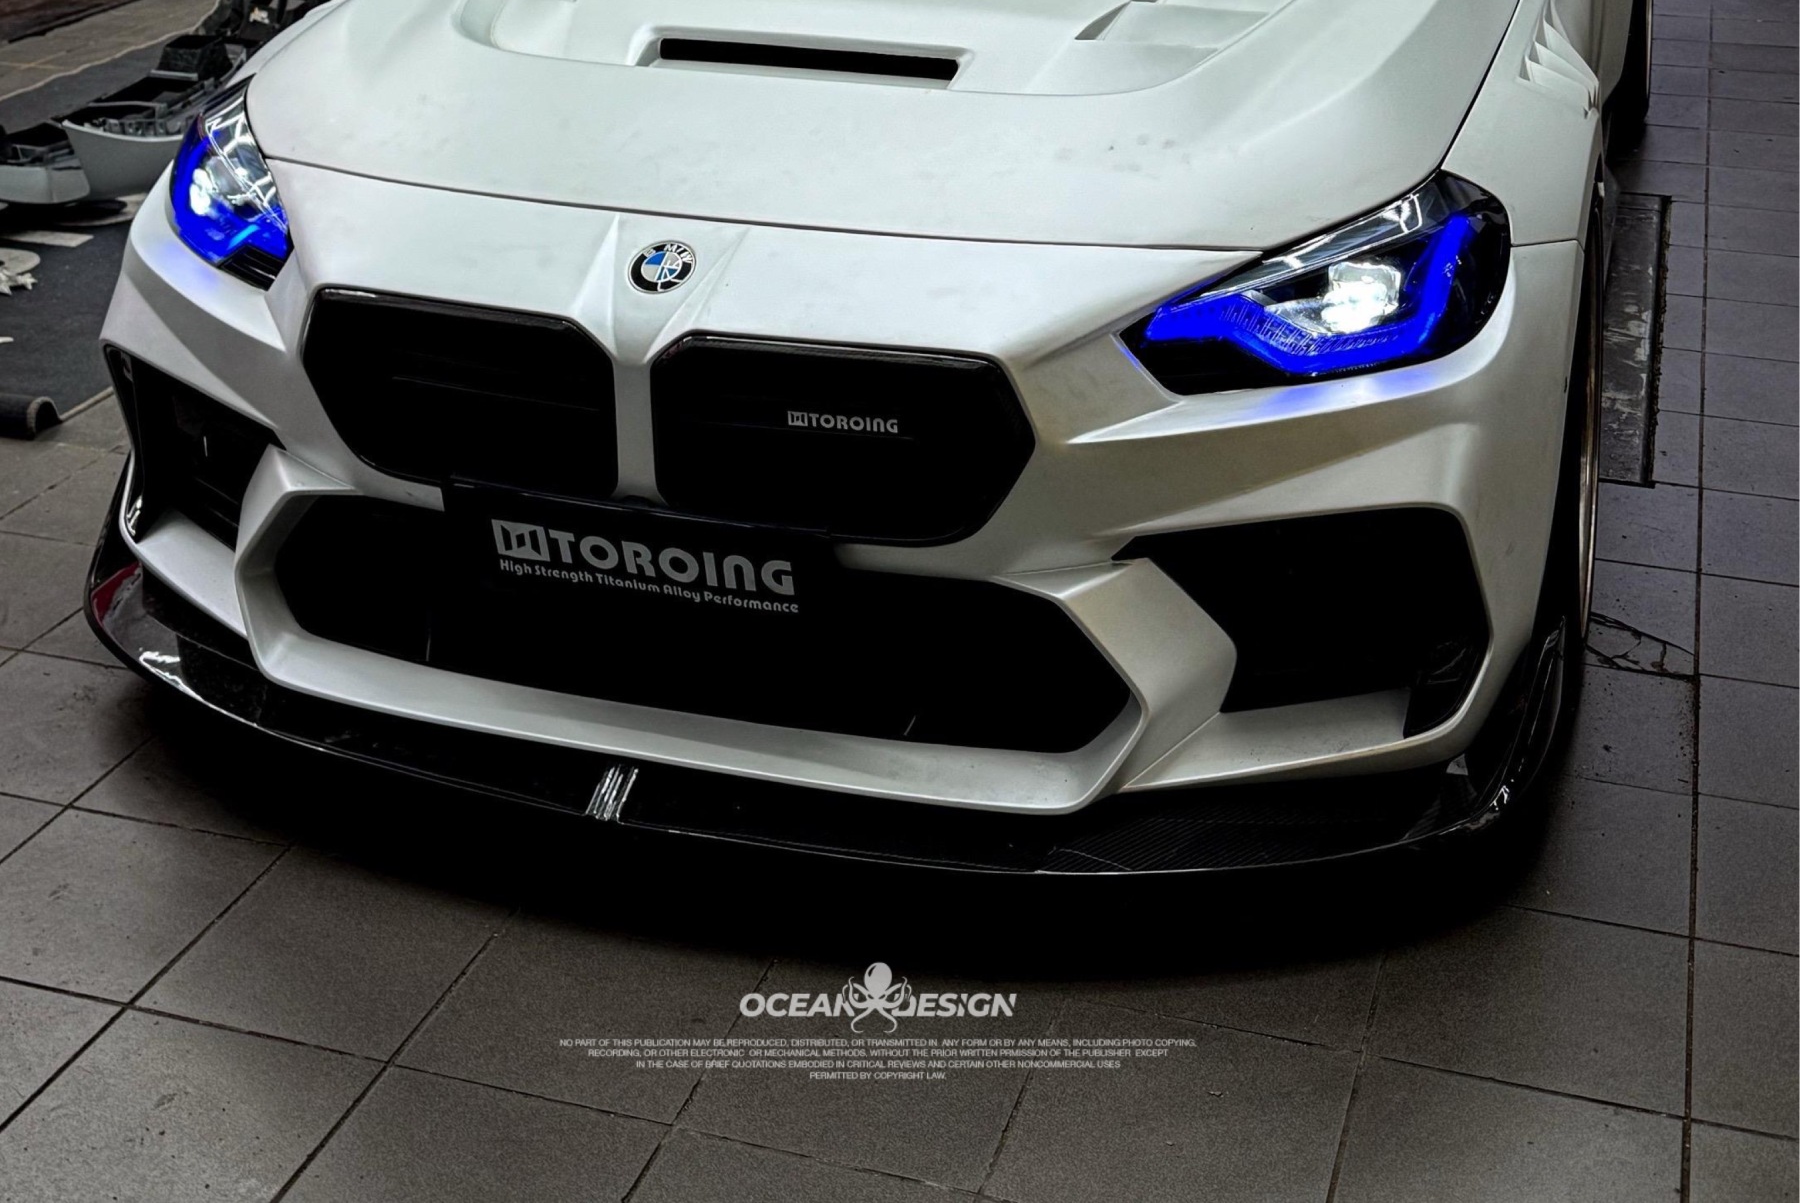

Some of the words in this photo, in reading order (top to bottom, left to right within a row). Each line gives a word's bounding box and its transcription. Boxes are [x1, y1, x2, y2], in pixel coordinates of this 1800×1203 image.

[809, 412, 898, 434] TOROING
[500, 558, 532, 576] High
[535, 564, 594, 583] Strength
[596, 573, 661, 594] Titanium
[663, 584, 701, 603] Alloy
[704, 590, 799, 613] Performance
[549, 528, 796, 597] TOROING
